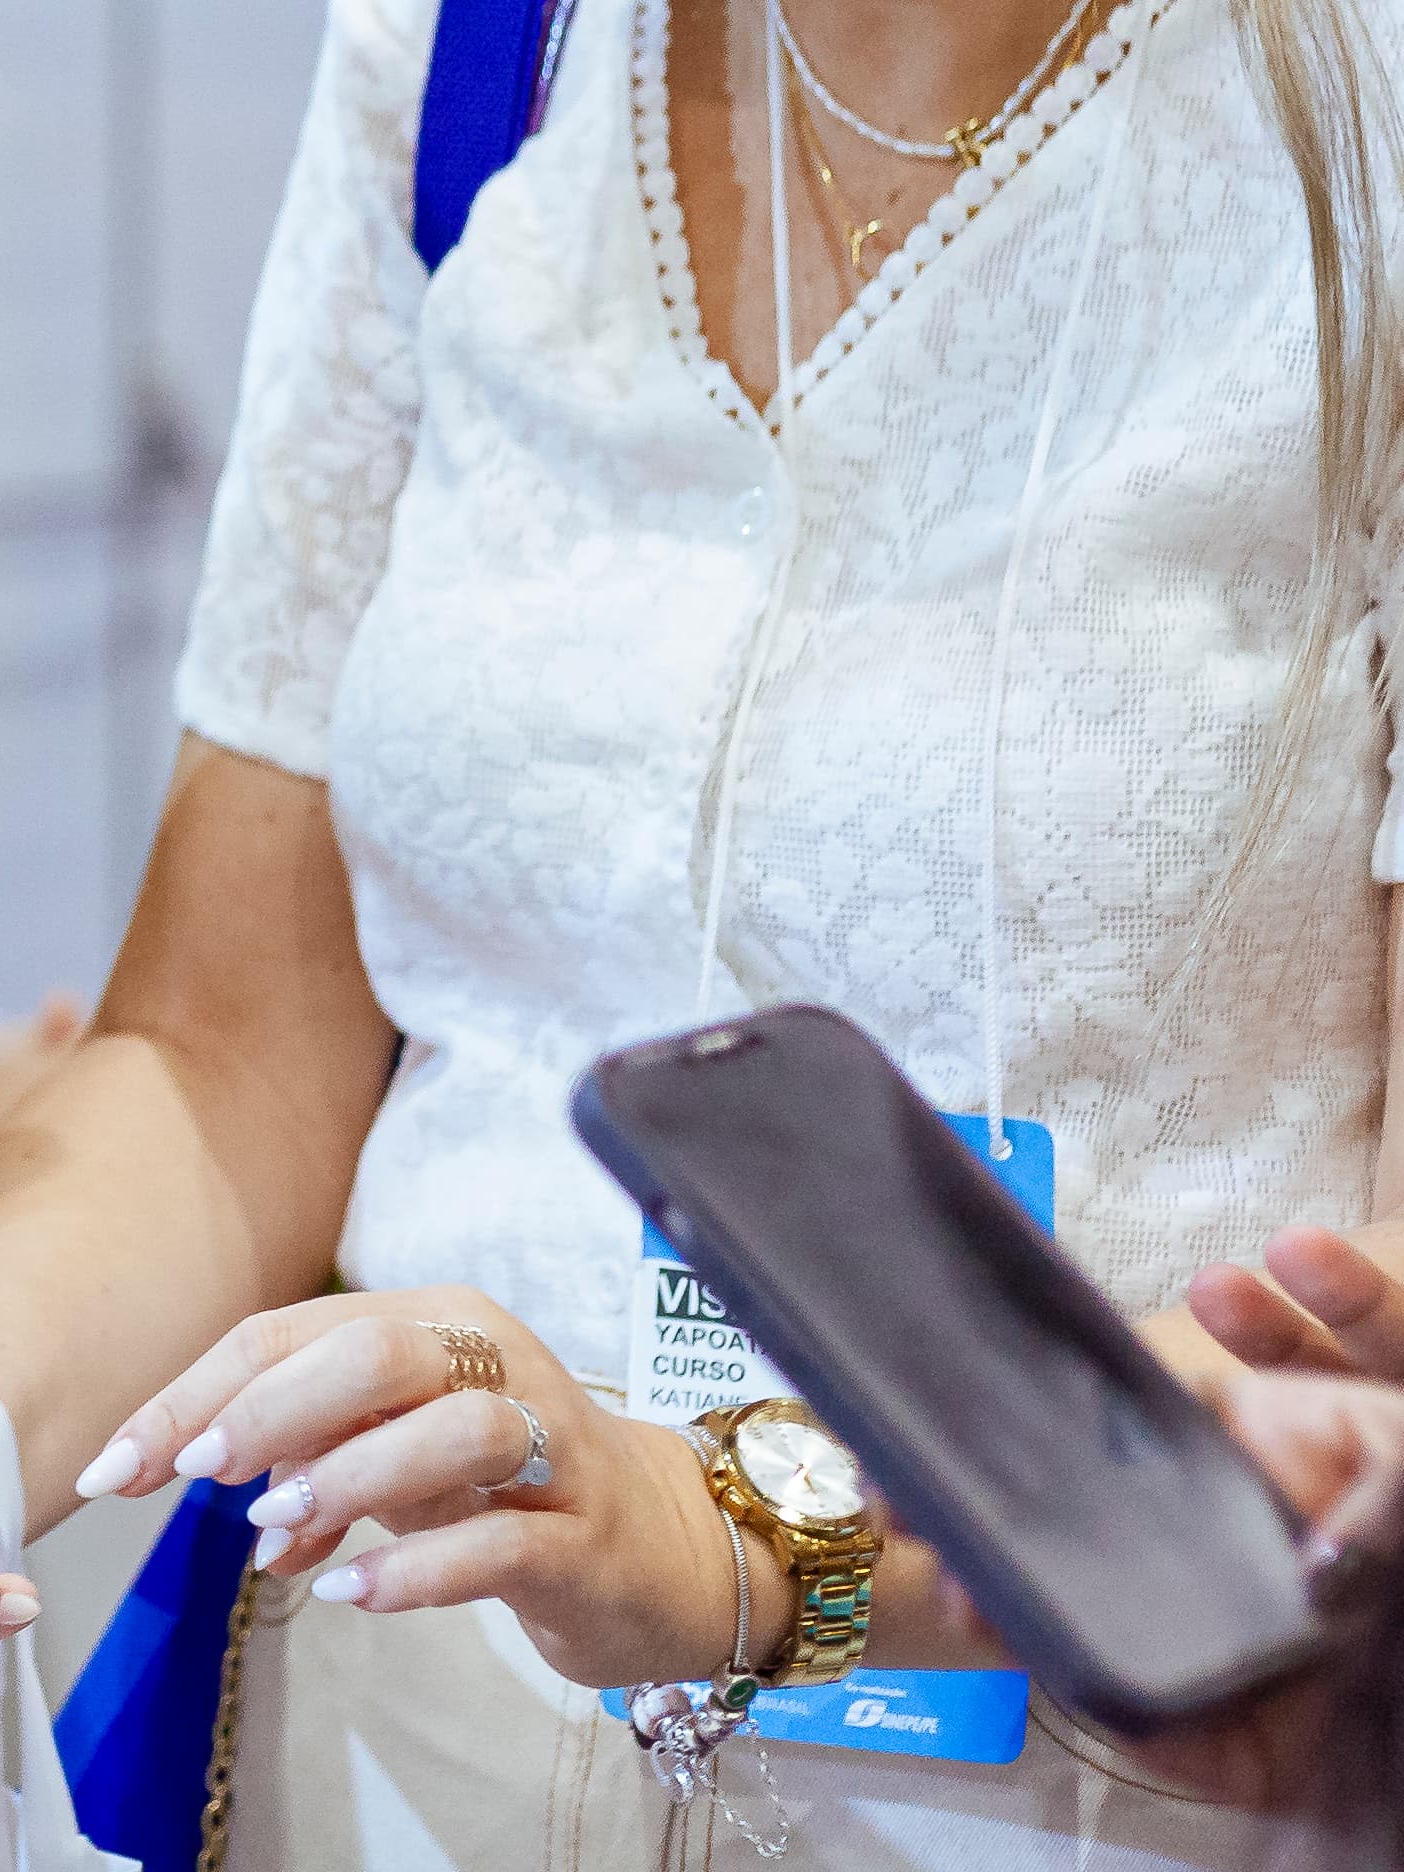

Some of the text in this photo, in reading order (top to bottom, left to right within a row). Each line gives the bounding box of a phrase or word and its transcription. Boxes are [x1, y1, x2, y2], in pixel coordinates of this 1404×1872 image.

[658, 1272, 727, 1320] VIS
[656, 1323, 758, 1354] YAPOAT
[653, 1355, 746, 1382] CURSO
